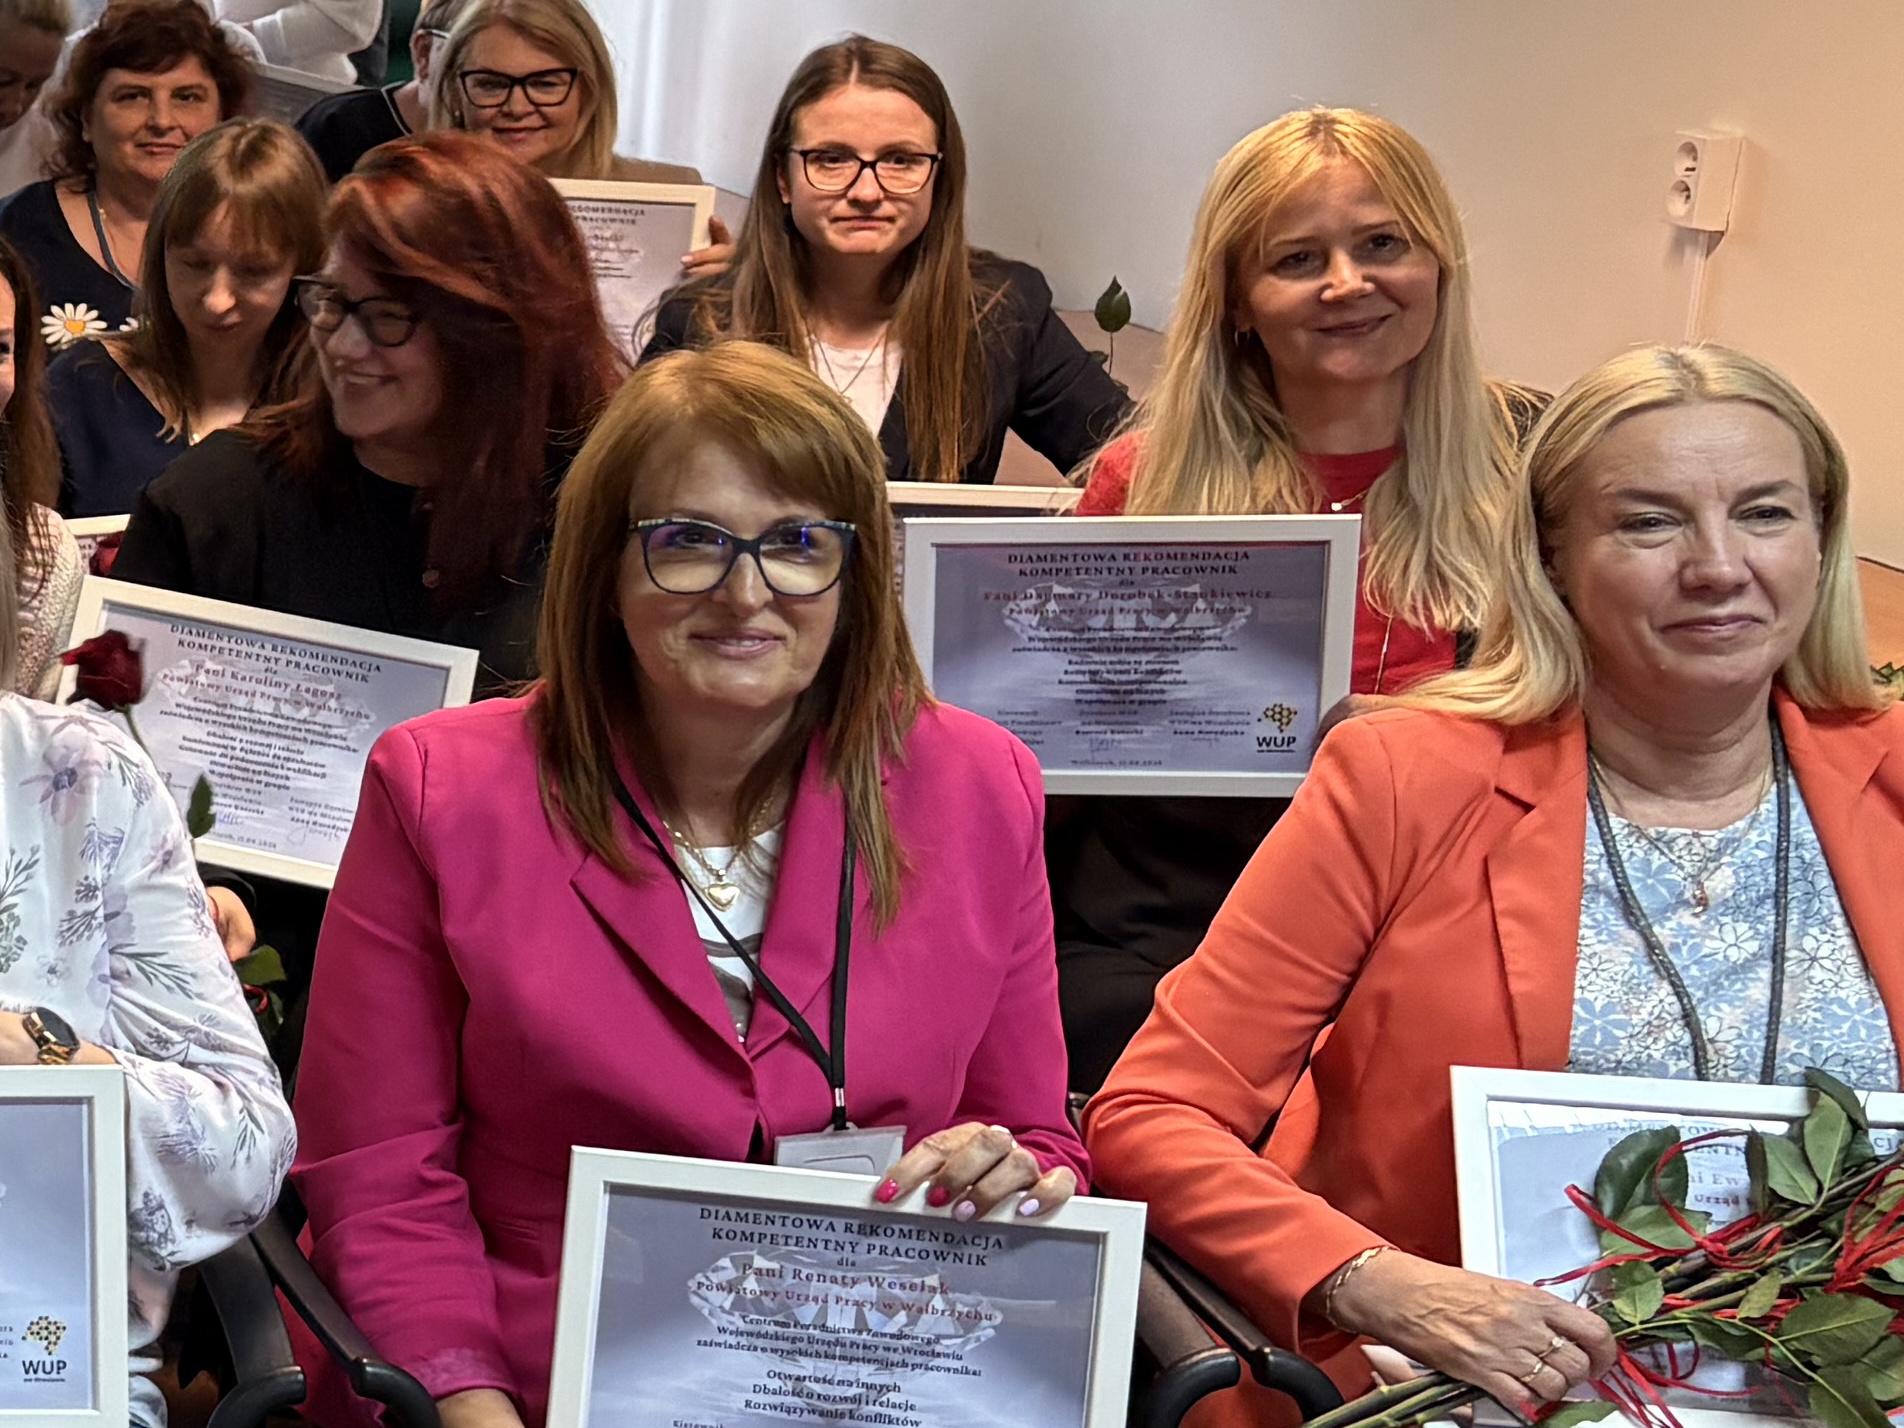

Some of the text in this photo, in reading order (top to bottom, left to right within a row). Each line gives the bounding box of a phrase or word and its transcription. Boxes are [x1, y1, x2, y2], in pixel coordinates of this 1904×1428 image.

[1007, 551, 1250, 564] DIAMENTOWA REKOMENDACJA
[1018, 564, 1238, 577] KOMPETENTNY PRACOWNIK
[170, 624, 382, 674] DIAMENTOWA REKOMENDACJA
[177, 637, 369, 683] KOMPETENTNY PRACOWNIK
[1255, 736, 1296, 748] WUP
[699, 1206, 1004, 1251] DIAMENTOWA REKOMENDACJA
[711, 1226, 988, 1267] KOMPETENTNY PRACOWNIK
[741, 1262, 784, 1279] Pani
[791, 1267, 860, 1290] Renaty
[836, 1256, 856, 1268] dla
[695, 1280, 780, 1302] Powiatowy
[834, 1294, 877, 1311] Pracy
[882, 1301, 894, 1311] w
[847, 1339, 880, 1354] Pracy
[21, 1359, 67, 1375] WUP
[766, 1368, 901, 1396] Otwartość na innych
[743, 1398, 922, 1428] Rozwiązywanie konfliktów
[816, 1390, 862, 1408] rozwój
[871, 1396, 917, 1414] relacje
